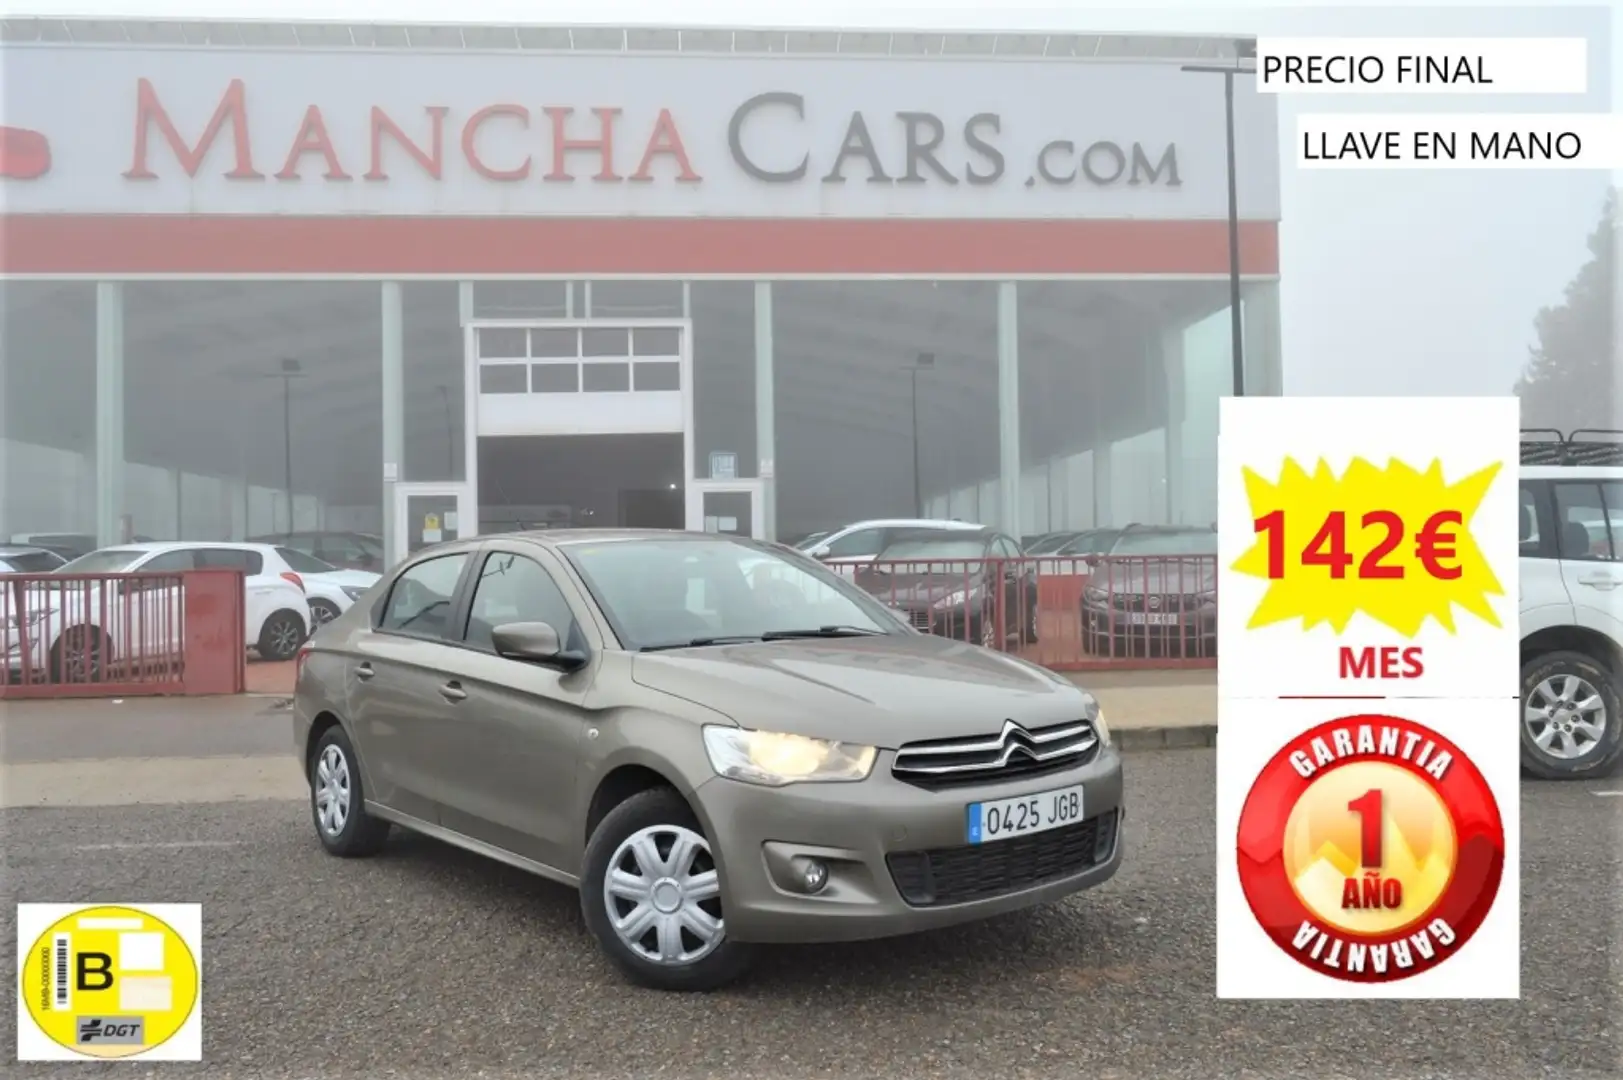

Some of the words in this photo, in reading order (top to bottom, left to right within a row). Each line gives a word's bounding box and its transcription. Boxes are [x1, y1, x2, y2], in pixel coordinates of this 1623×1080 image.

[120, 77, 703, 182] MANCHA
[987, 800, 1040, 835] 0425
[1047, 792, 1079, 824] JGB
